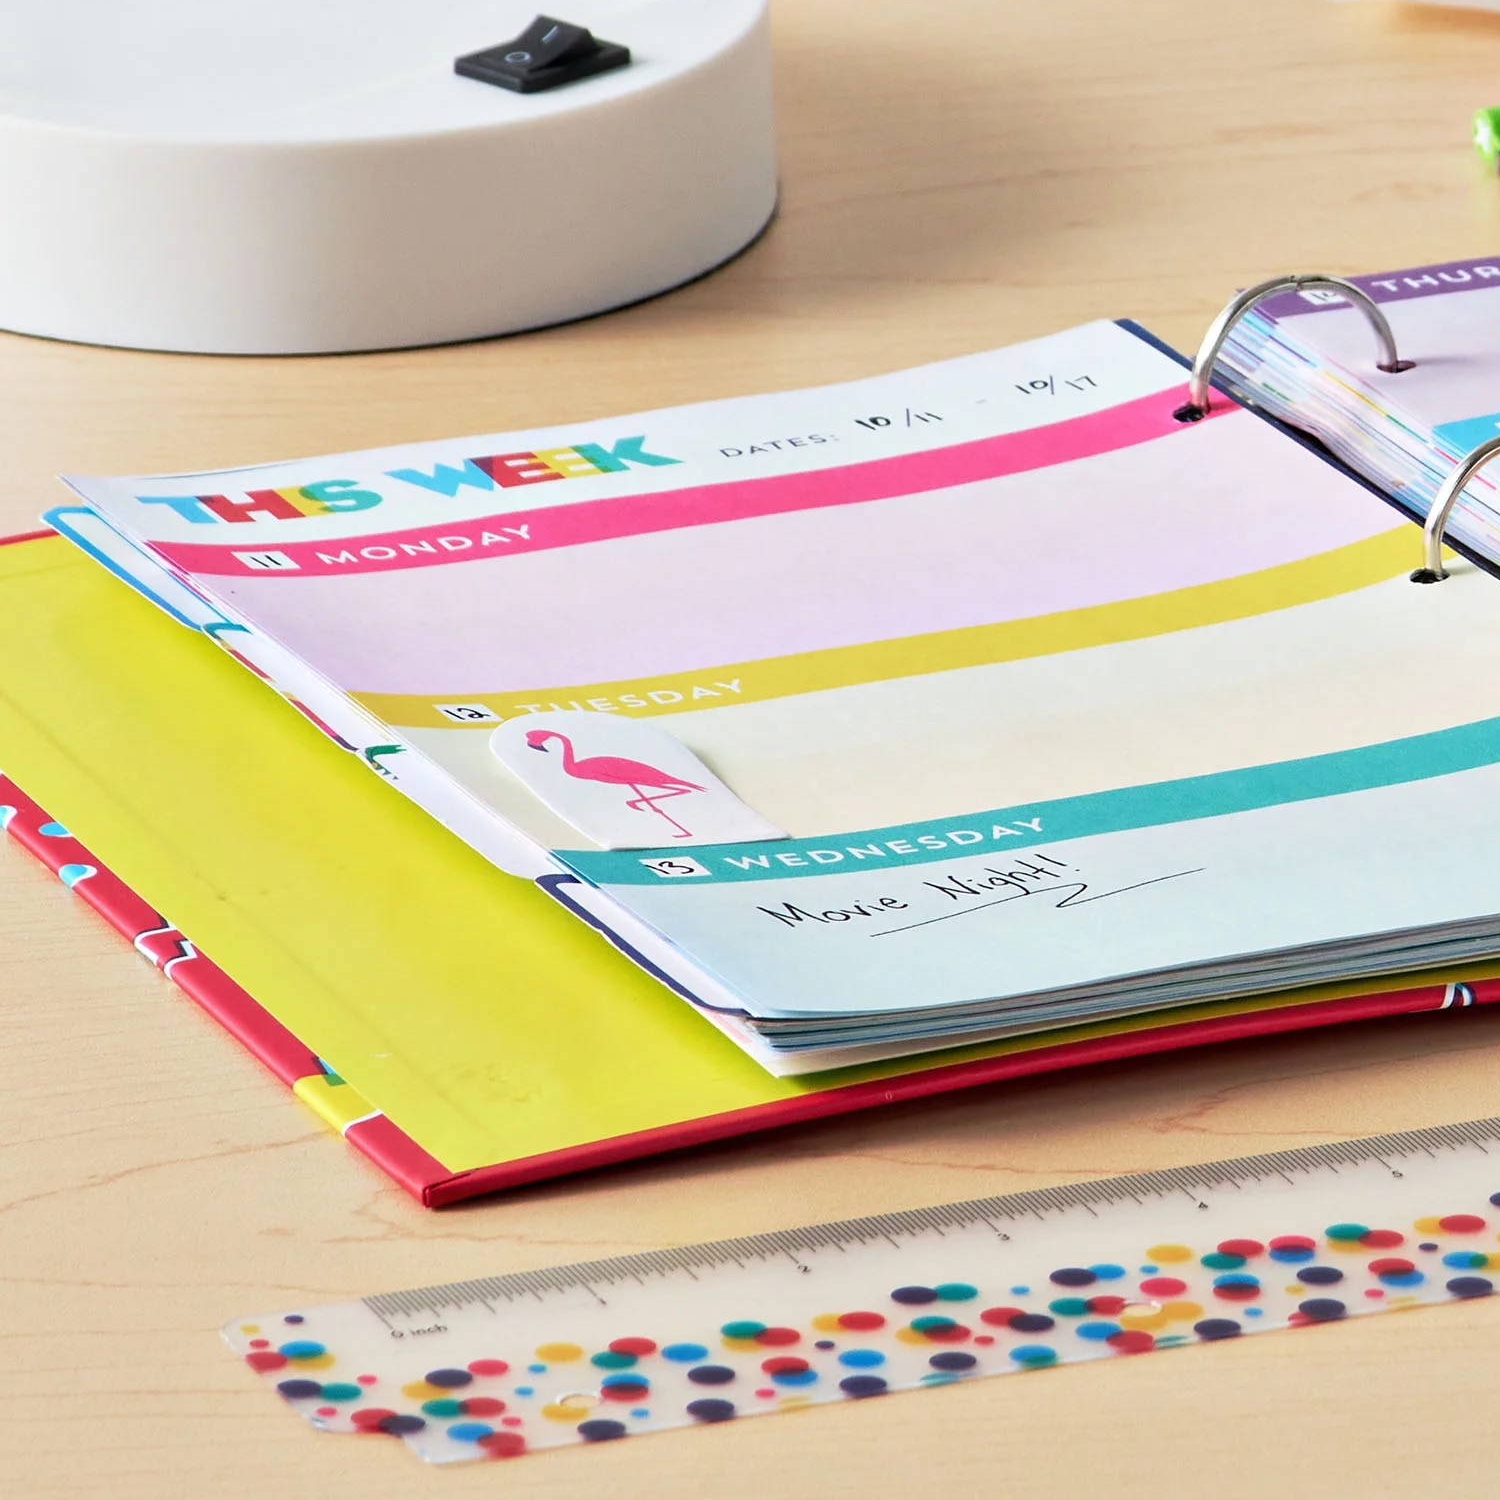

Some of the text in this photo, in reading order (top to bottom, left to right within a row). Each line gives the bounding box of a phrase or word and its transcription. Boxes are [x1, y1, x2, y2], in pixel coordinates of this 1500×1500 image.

[720, 433, 840, 458] DATES:
[135, 435, 684, 524] THIS WEEK
[249, 524, 533, 568] 11 MONDAY
[444, 678, 742, 721] 12 TUESDAY
[643, 817, 1047, 878] 13 WEDNESDAY
[757, 853, 1081, 928] Movie Night!
[410, 1324, 448, 1336] inch
[797, 1262, 811, 1273] 2
